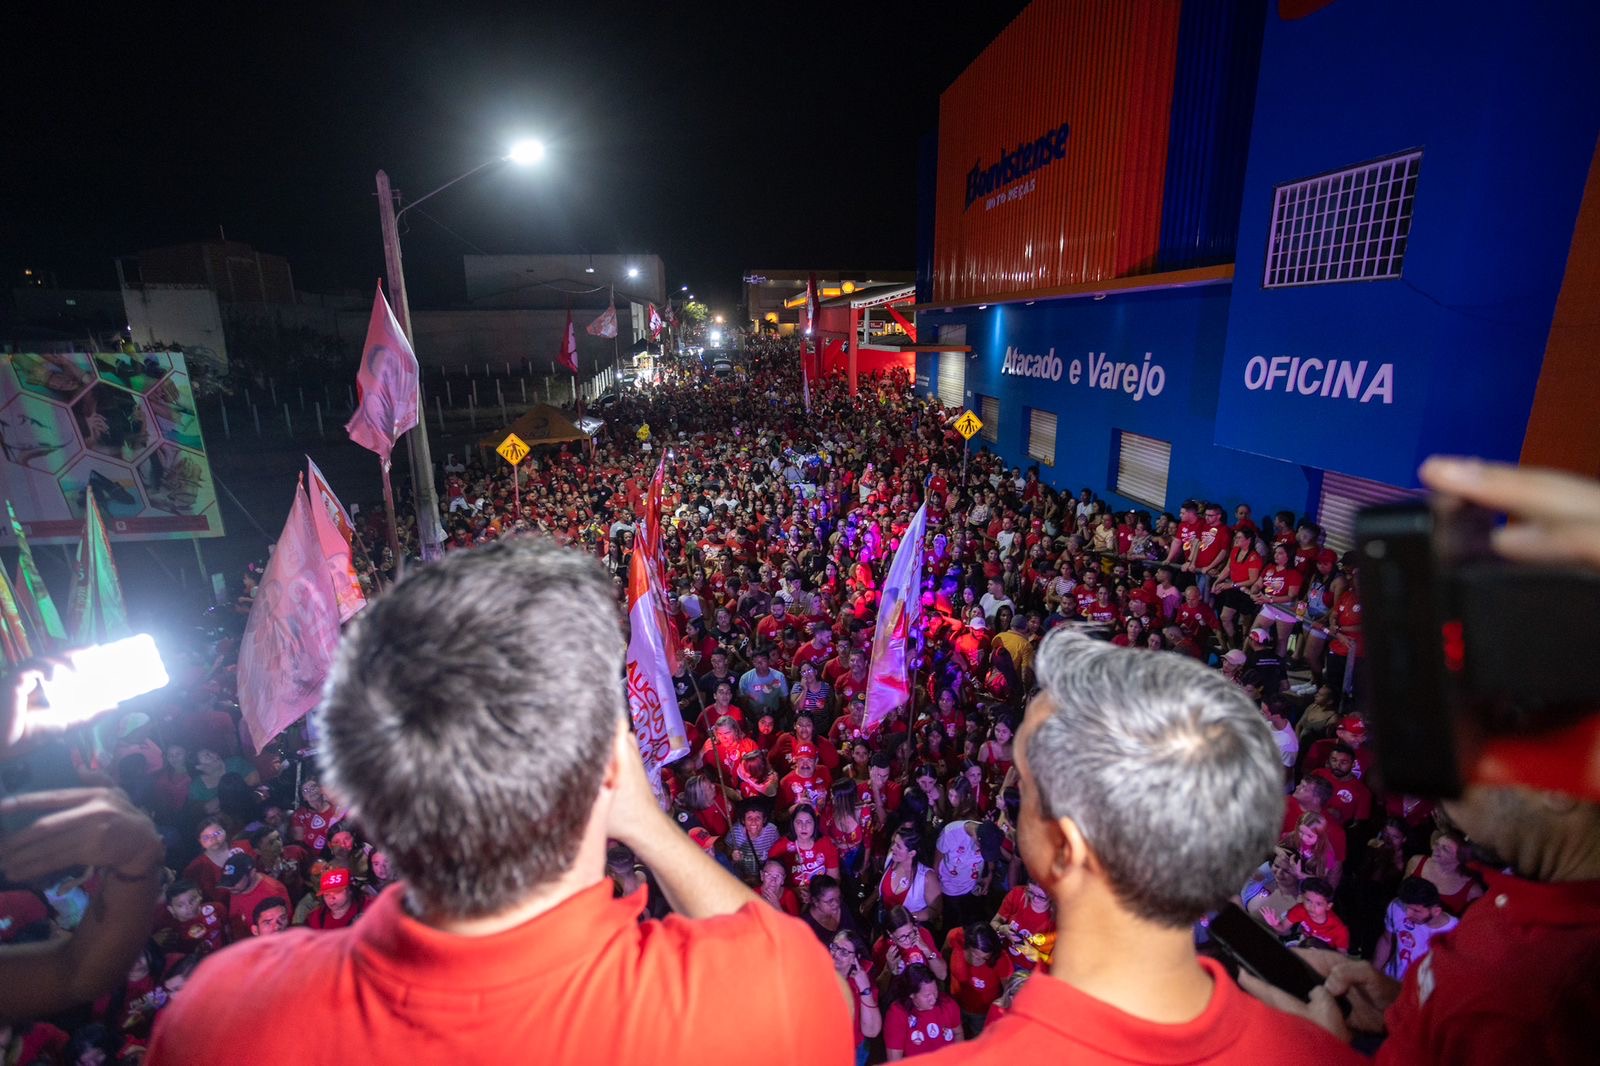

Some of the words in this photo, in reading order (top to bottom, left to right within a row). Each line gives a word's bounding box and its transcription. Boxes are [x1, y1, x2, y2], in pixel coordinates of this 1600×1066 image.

[1001, 345, 1064, 382] Atacado
[1069, 359, 1083, 385] e
[1088, 351, 1166, 402] Varejo
[1244, 355, 1394, 404] OFICINA
[329, 874, 343, 884] 55
